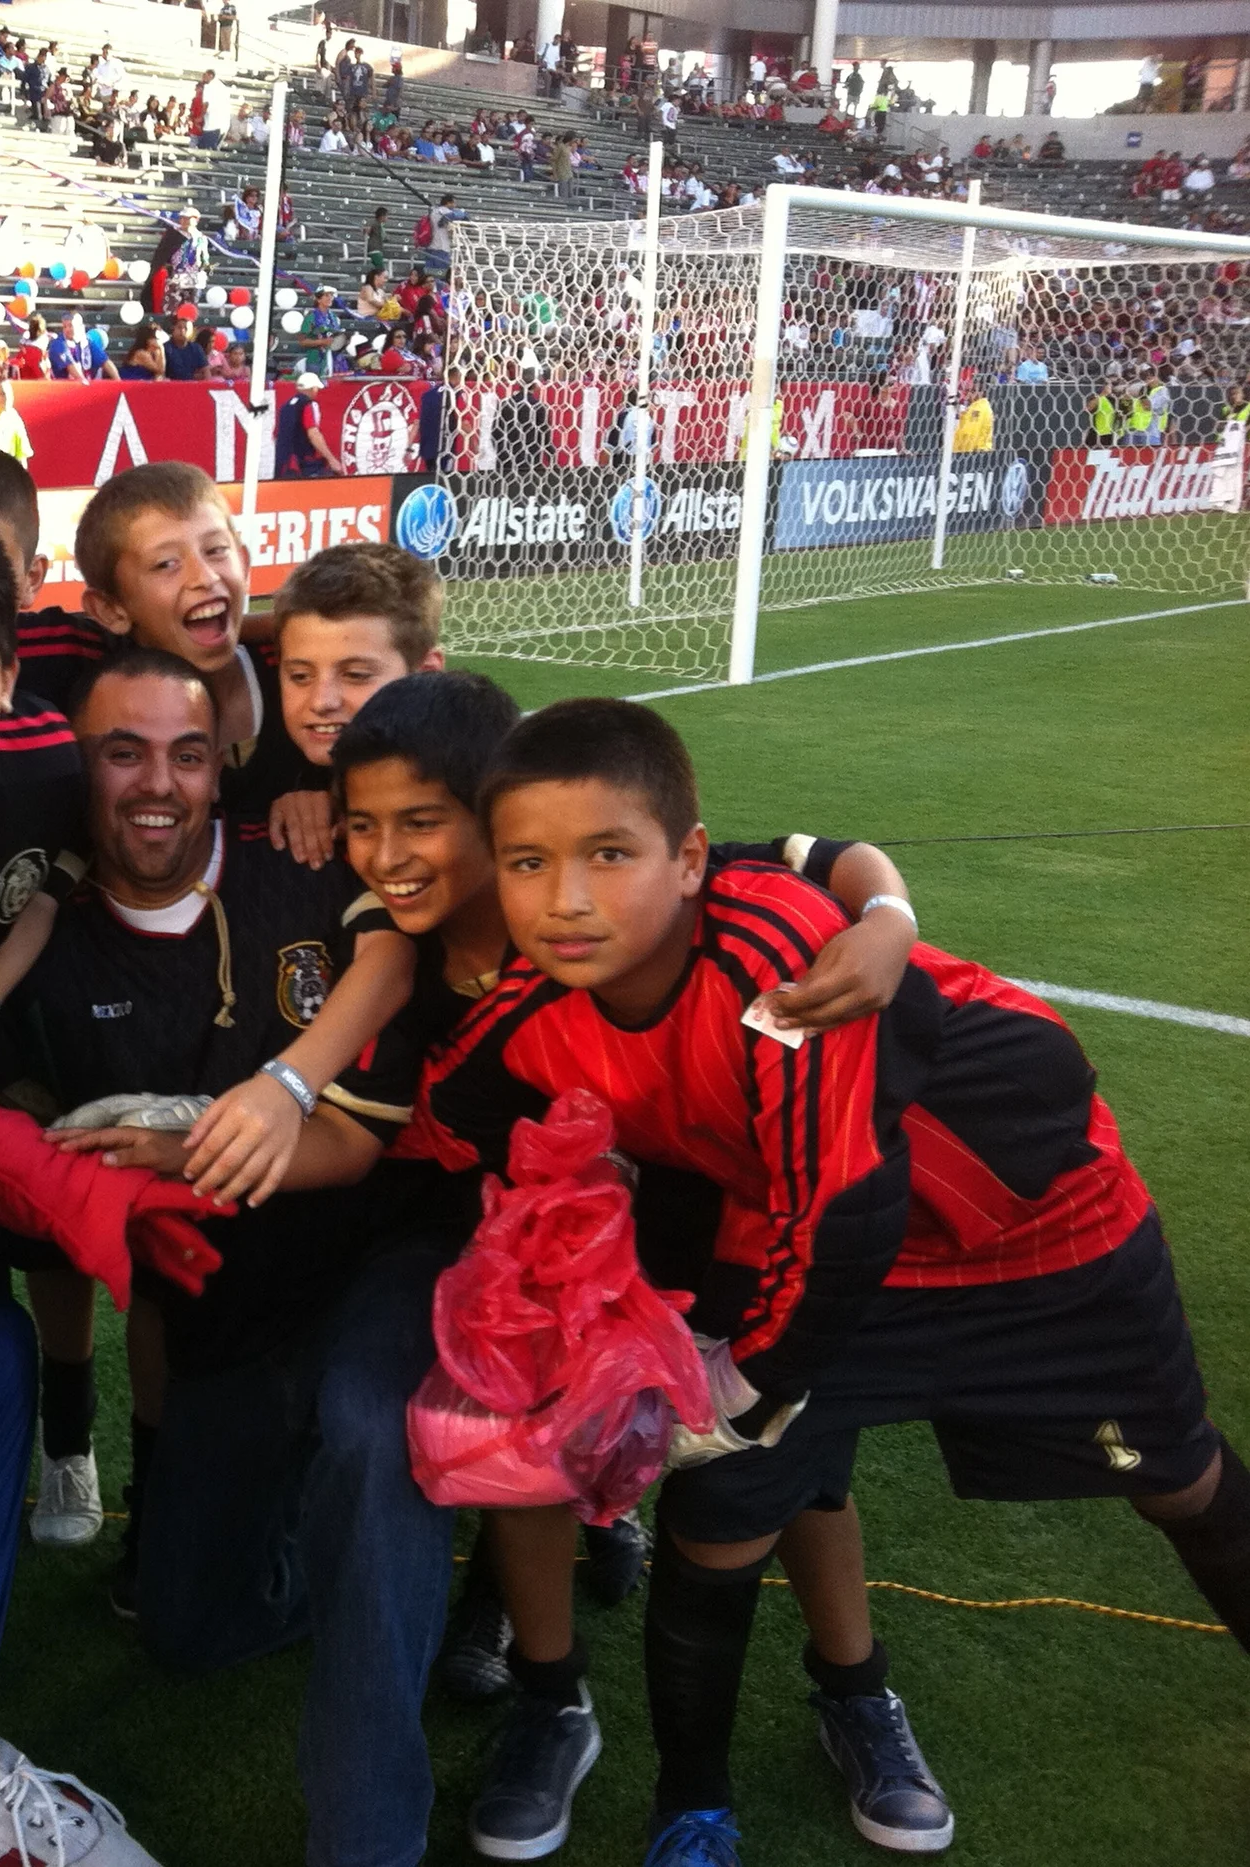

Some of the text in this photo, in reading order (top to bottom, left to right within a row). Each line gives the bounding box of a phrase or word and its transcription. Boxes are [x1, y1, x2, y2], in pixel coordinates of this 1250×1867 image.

[458, 493, 586, 548] Allstate
[662, 484, 742, 533] Allsta
[802, 471, 994, 525] VOLKSWAGEN
[234, 504, 382, 568] ERIES
